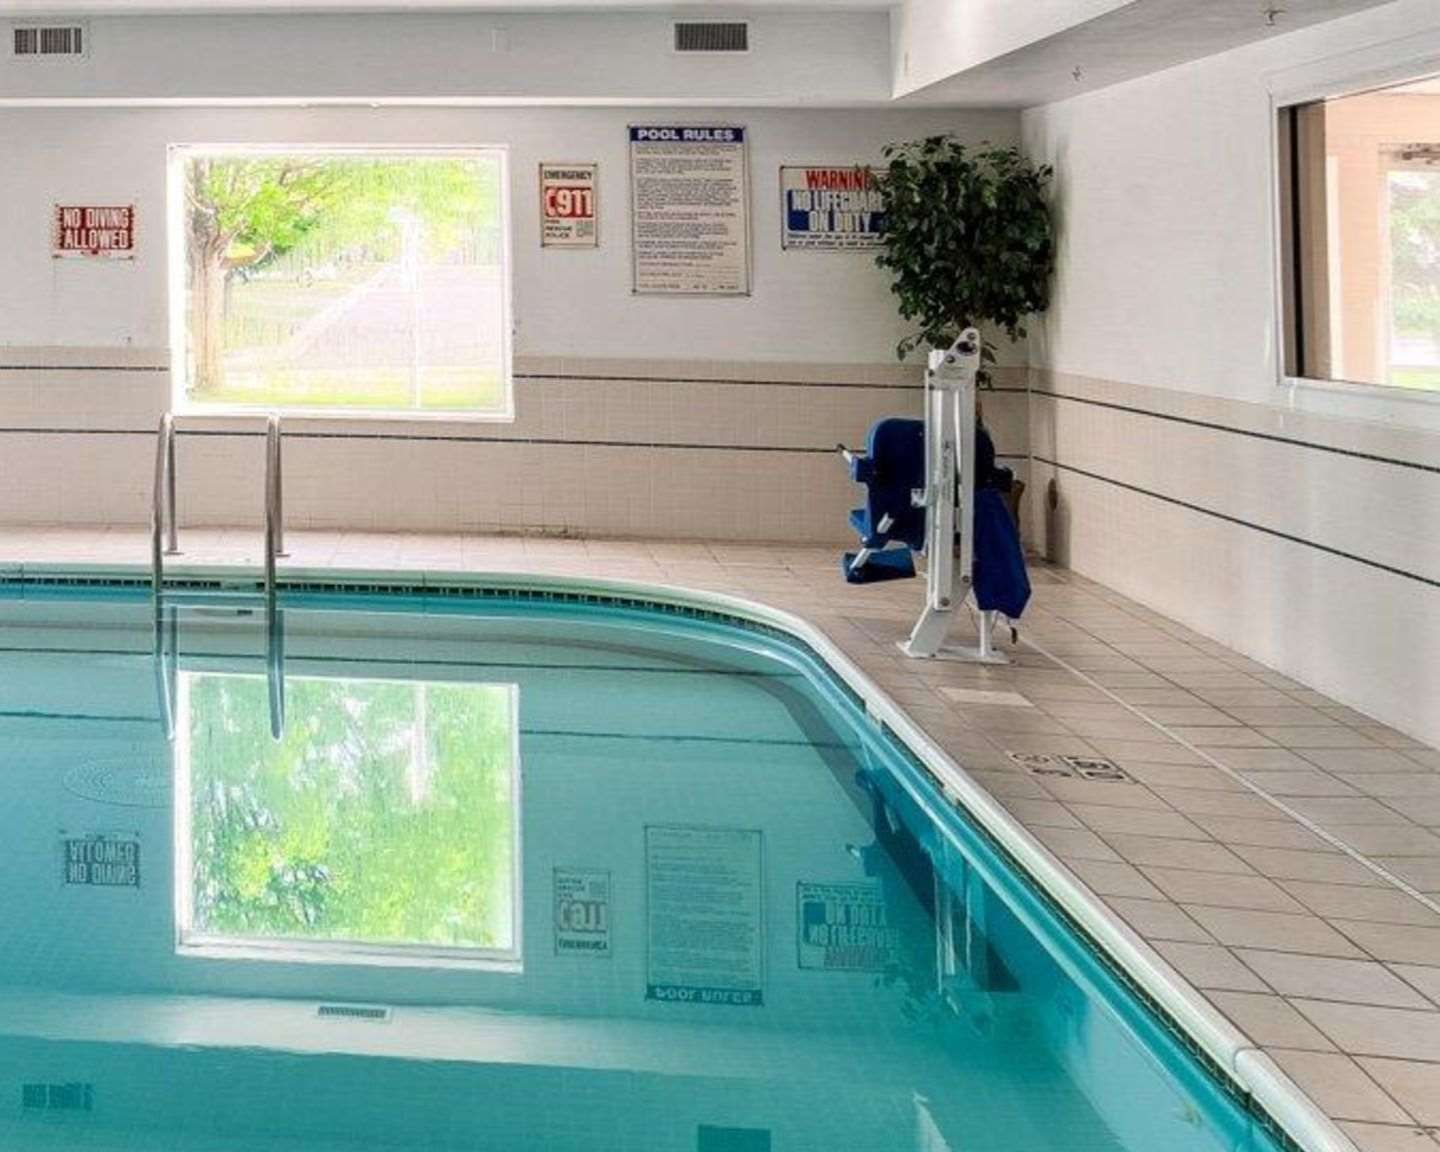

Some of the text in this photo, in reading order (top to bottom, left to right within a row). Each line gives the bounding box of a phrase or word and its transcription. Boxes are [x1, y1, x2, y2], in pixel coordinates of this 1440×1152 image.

[637, 129, 734, 141] POOL RULES
[557, 189, 592, 215] 911
[792, 191, 811, 211] NO
[63, 208, 129, 229] NO DIVING
[809, 211, 871, 233] ON DUTY
[63, 229, 129, 249] ALLOWED
